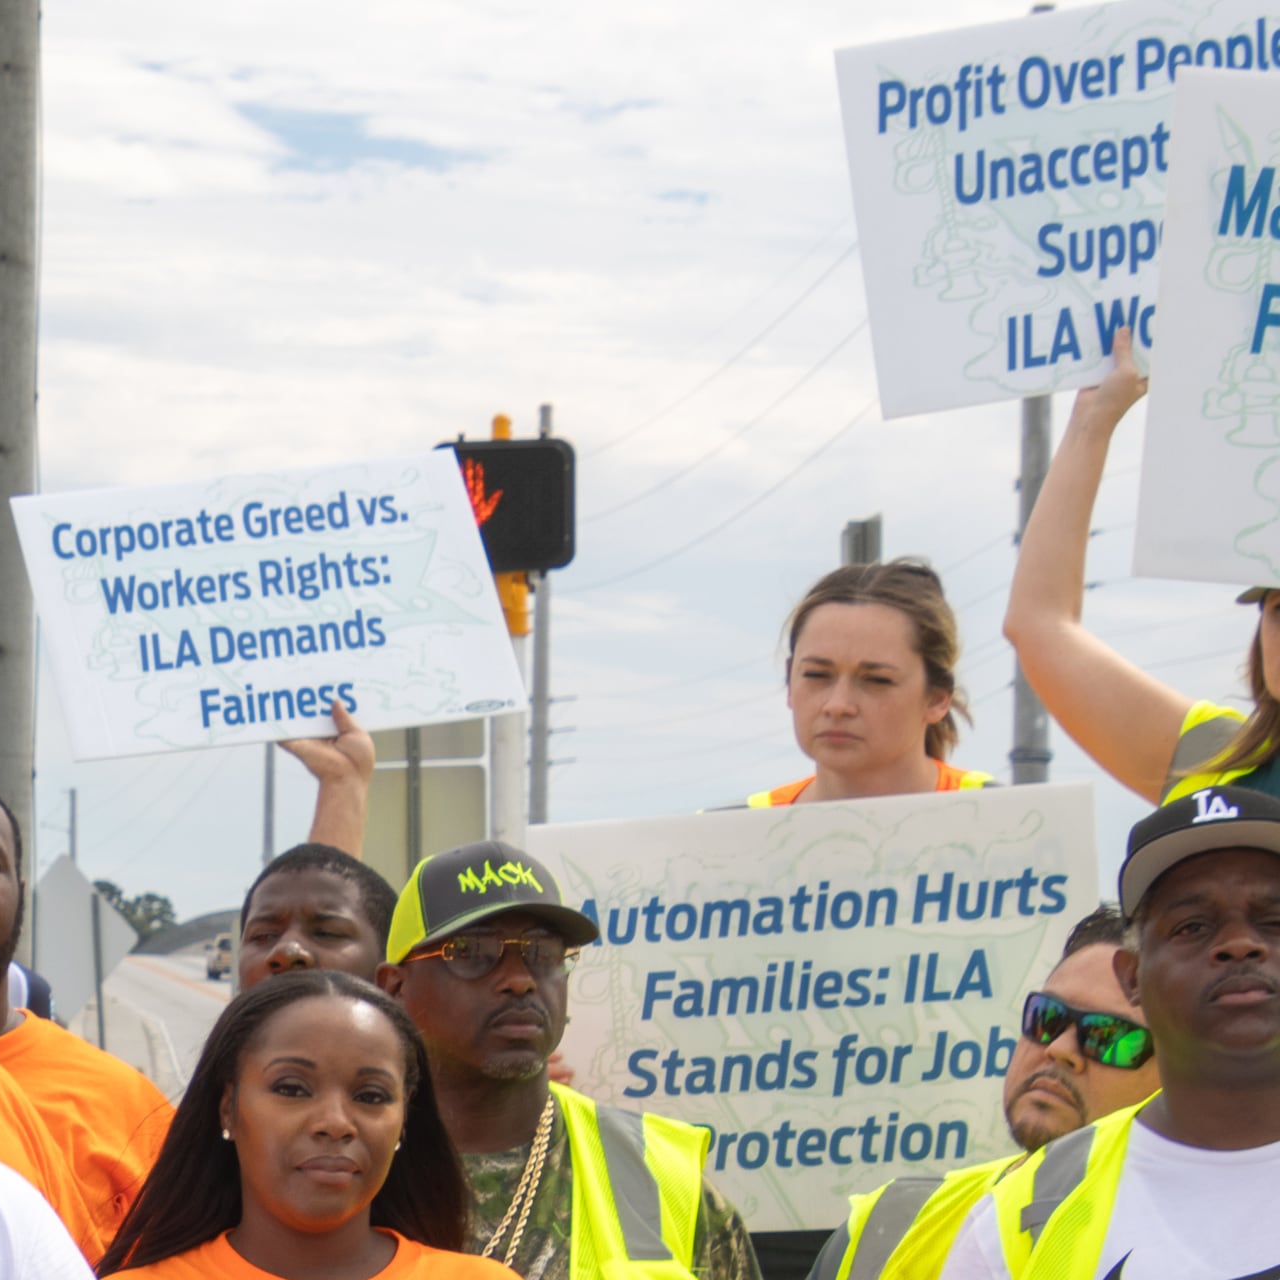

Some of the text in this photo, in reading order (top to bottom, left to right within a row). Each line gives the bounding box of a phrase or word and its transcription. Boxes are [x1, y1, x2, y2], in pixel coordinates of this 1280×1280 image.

[878, 64, 1006, 134] Profit
[1018, 55, 1124, 110] Over
[1008, 308, 1082, 372] ILA
[52, 491, 408, 561] Corporate Greed vs.
[100, 552, 391, 615] Workers Rights:
[139, 609, 386, 672] ILA Demands
[199, 683, 357, 729] Fairness
[1192, 789, 1239, 823] LA
[458, 860, 543, 894] MACK
[913, 868, 1066, 923] Hurts
[643, 950, 991, 1019] Families: ILA
[626, 1027, 1015, 1096] Stands for Job
[692, 1110, 968, 1171] rotection
